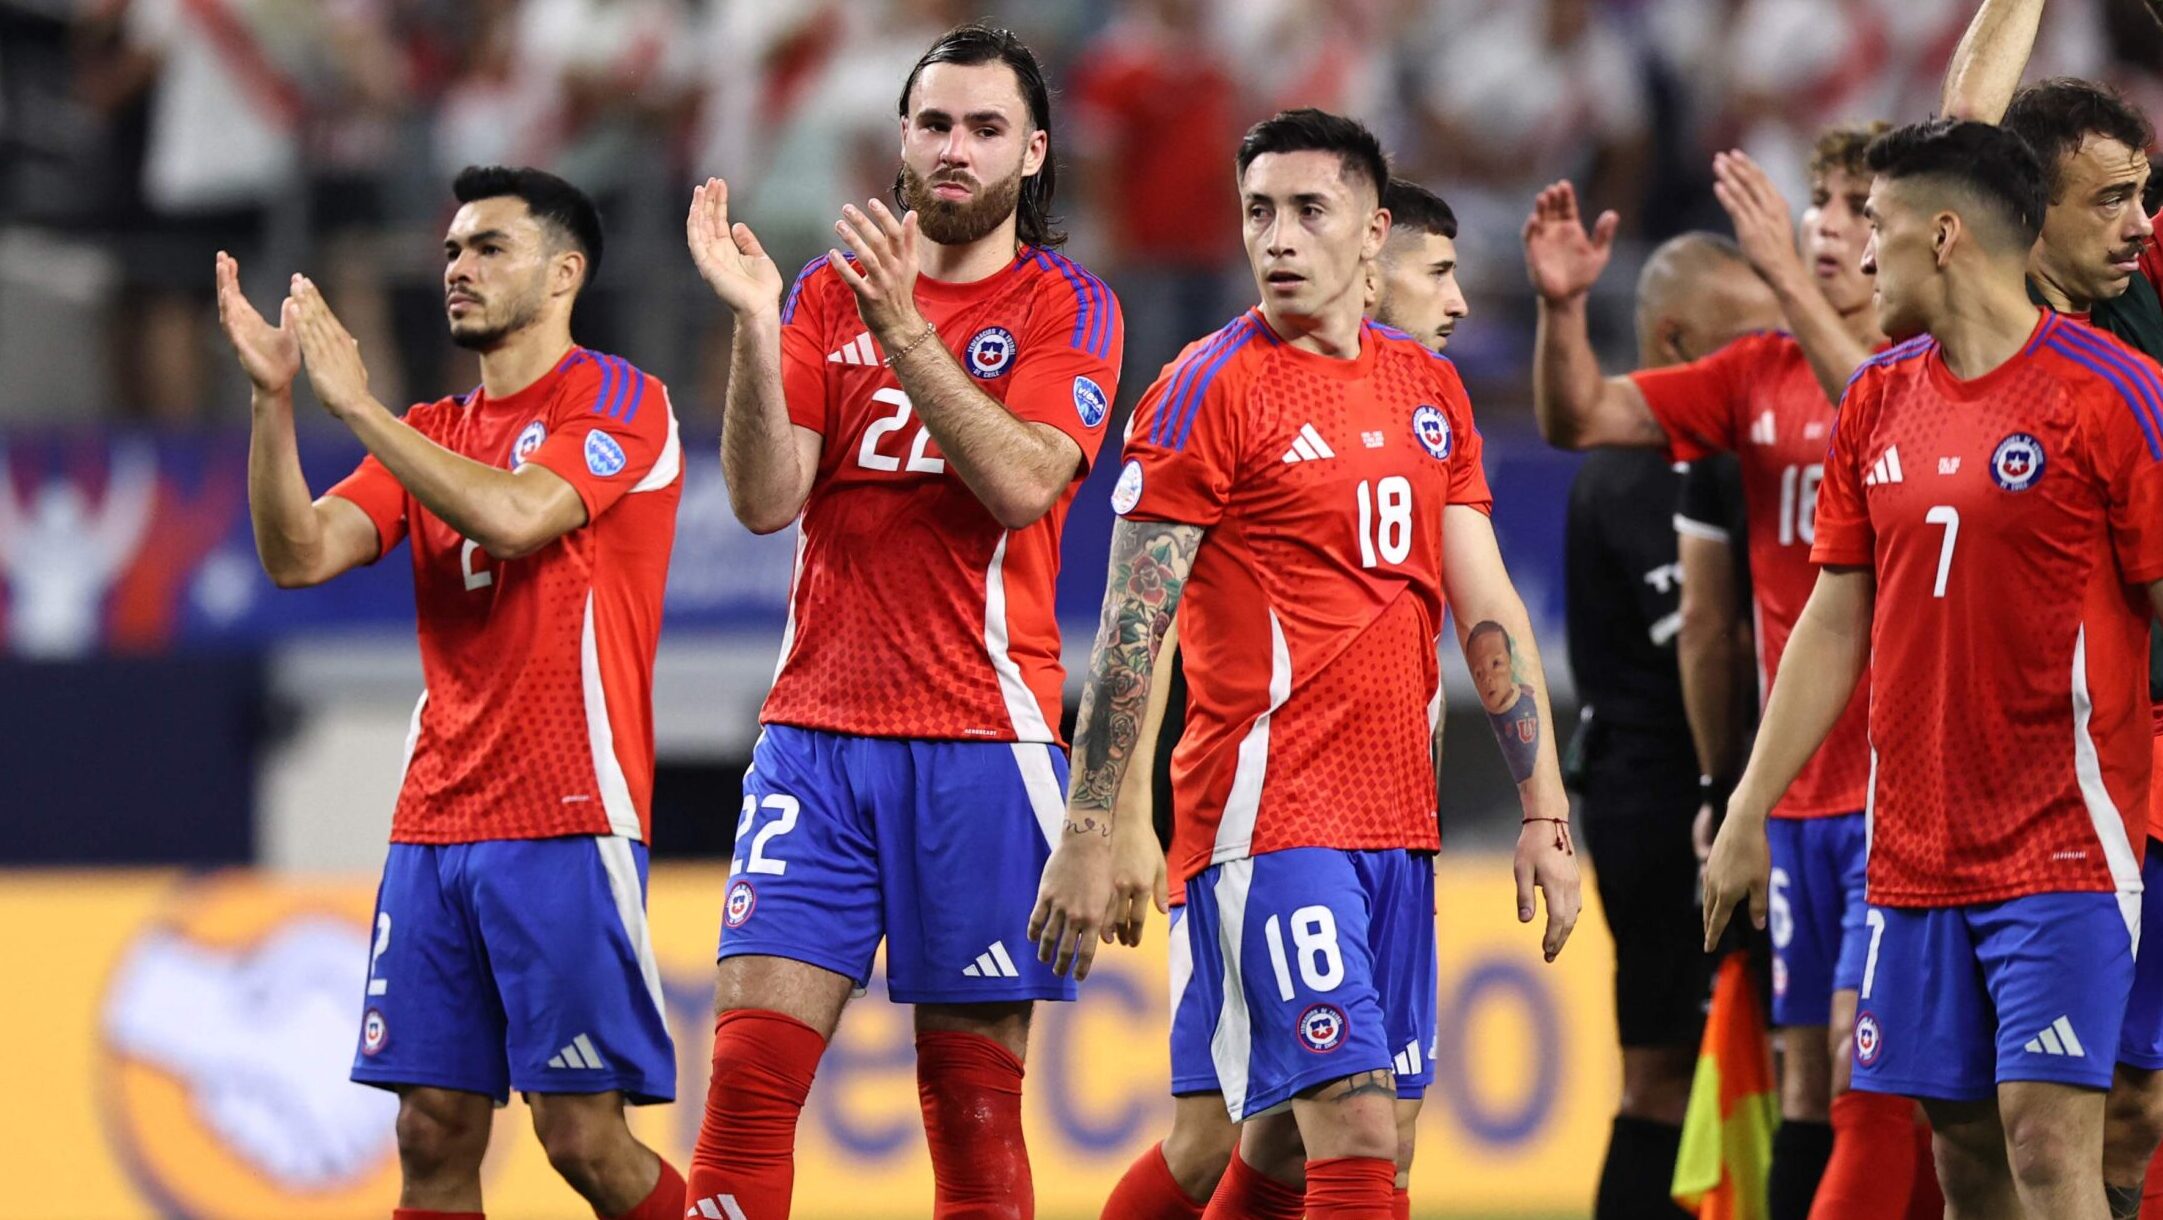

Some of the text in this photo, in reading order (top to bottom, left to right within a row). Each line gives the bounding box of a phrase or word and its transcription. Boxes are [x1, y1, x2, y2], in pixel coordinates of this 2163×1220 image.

[1357, 475, 1413, 569] 18
[1925, 505, 1960, 597] 7
[729, 793, 800, 876] 22
[367, 911, 392, 995] 2
[1264, 905, 1344, 1002] 18
[1861, 907, 1885, 999] 7
